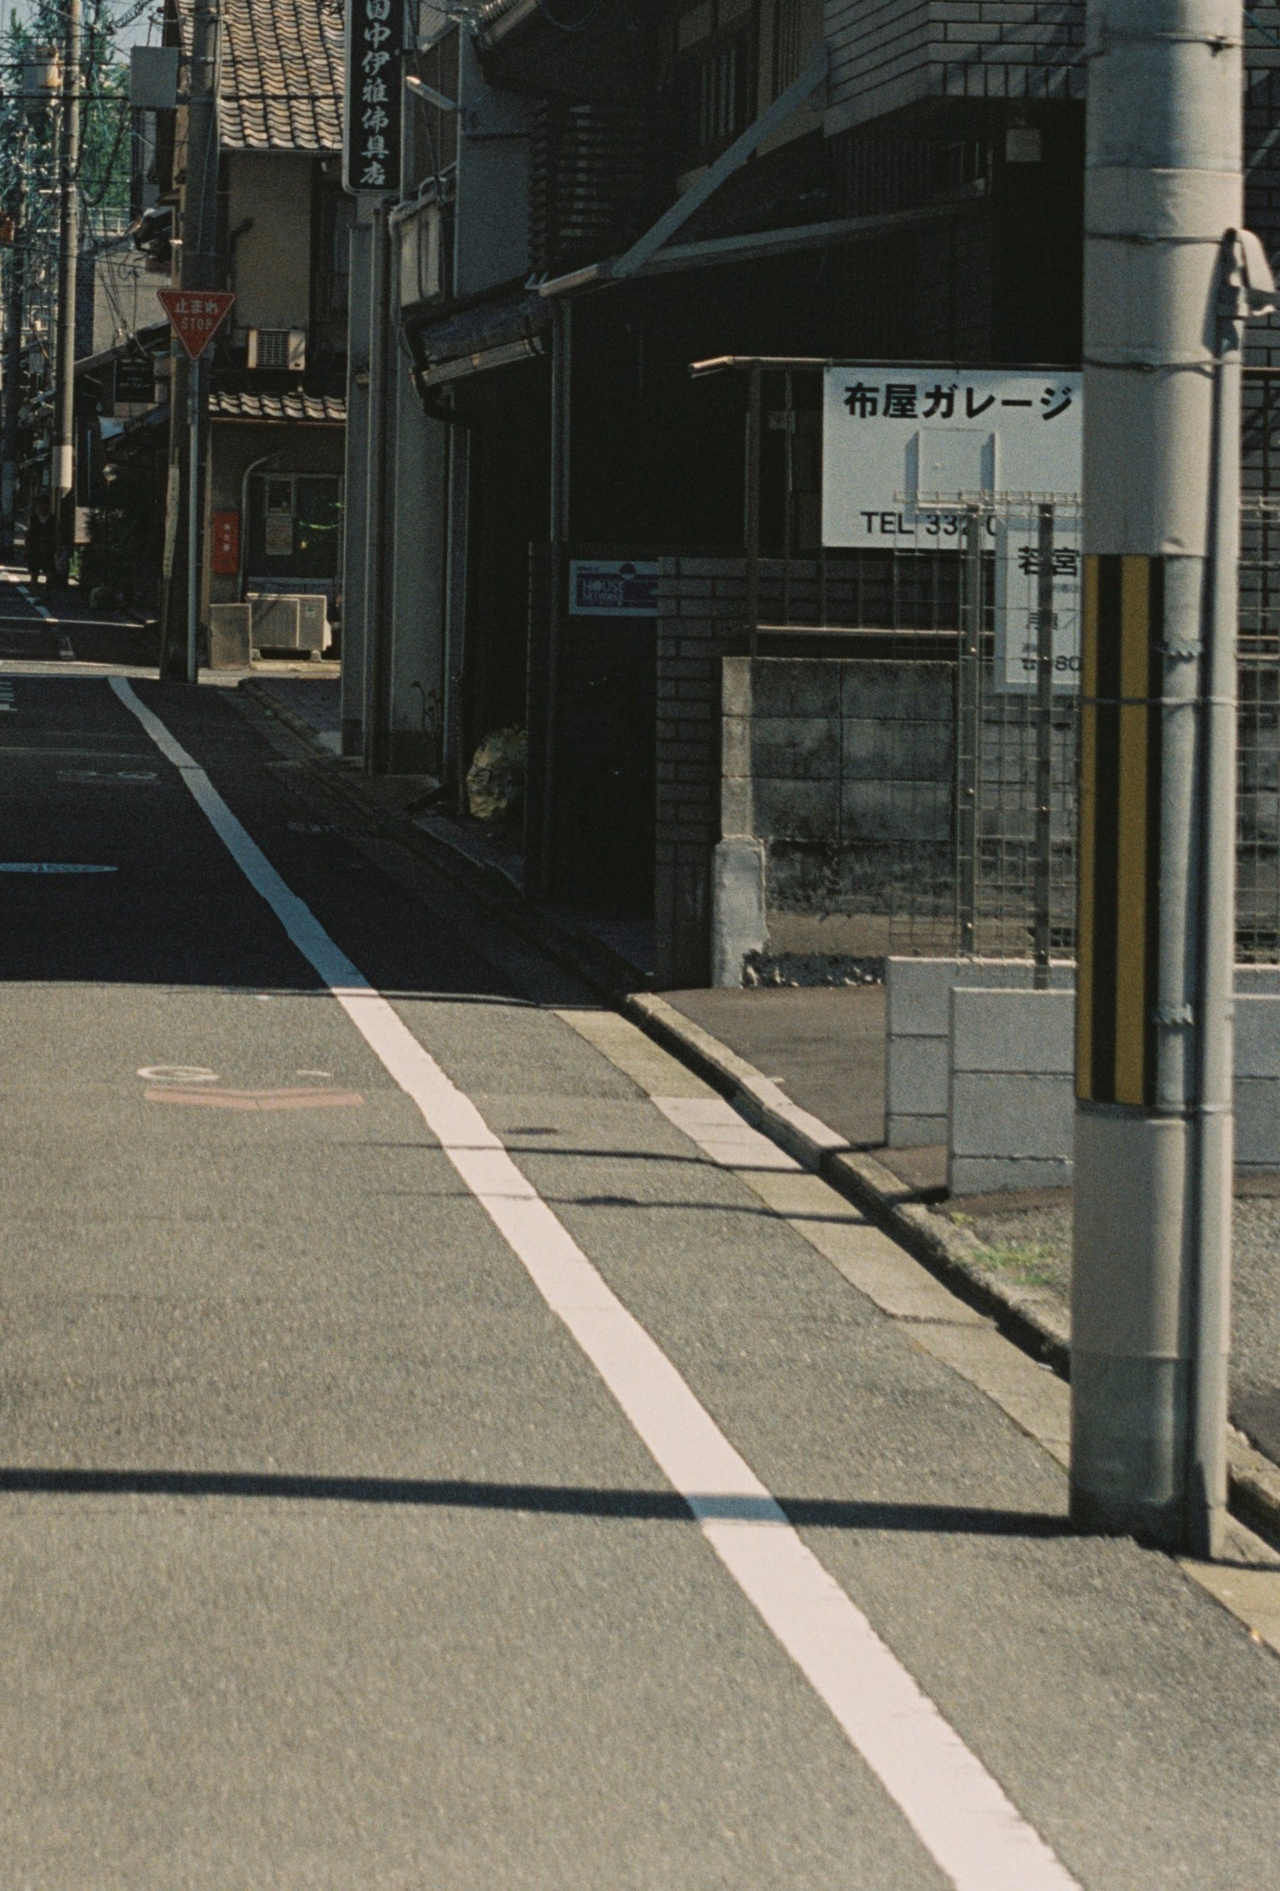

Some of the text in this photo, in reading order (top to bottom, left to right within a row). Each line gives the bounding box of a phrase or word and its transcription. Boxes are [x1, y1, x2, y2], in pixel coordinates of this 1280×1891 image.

[175, 297, 219, 315] 止まれ
[181, 317, 213, 330] STOP
[843, 381, 1073, 421] 布屋ガレージ
[860, 511, 915, 535] TEL
